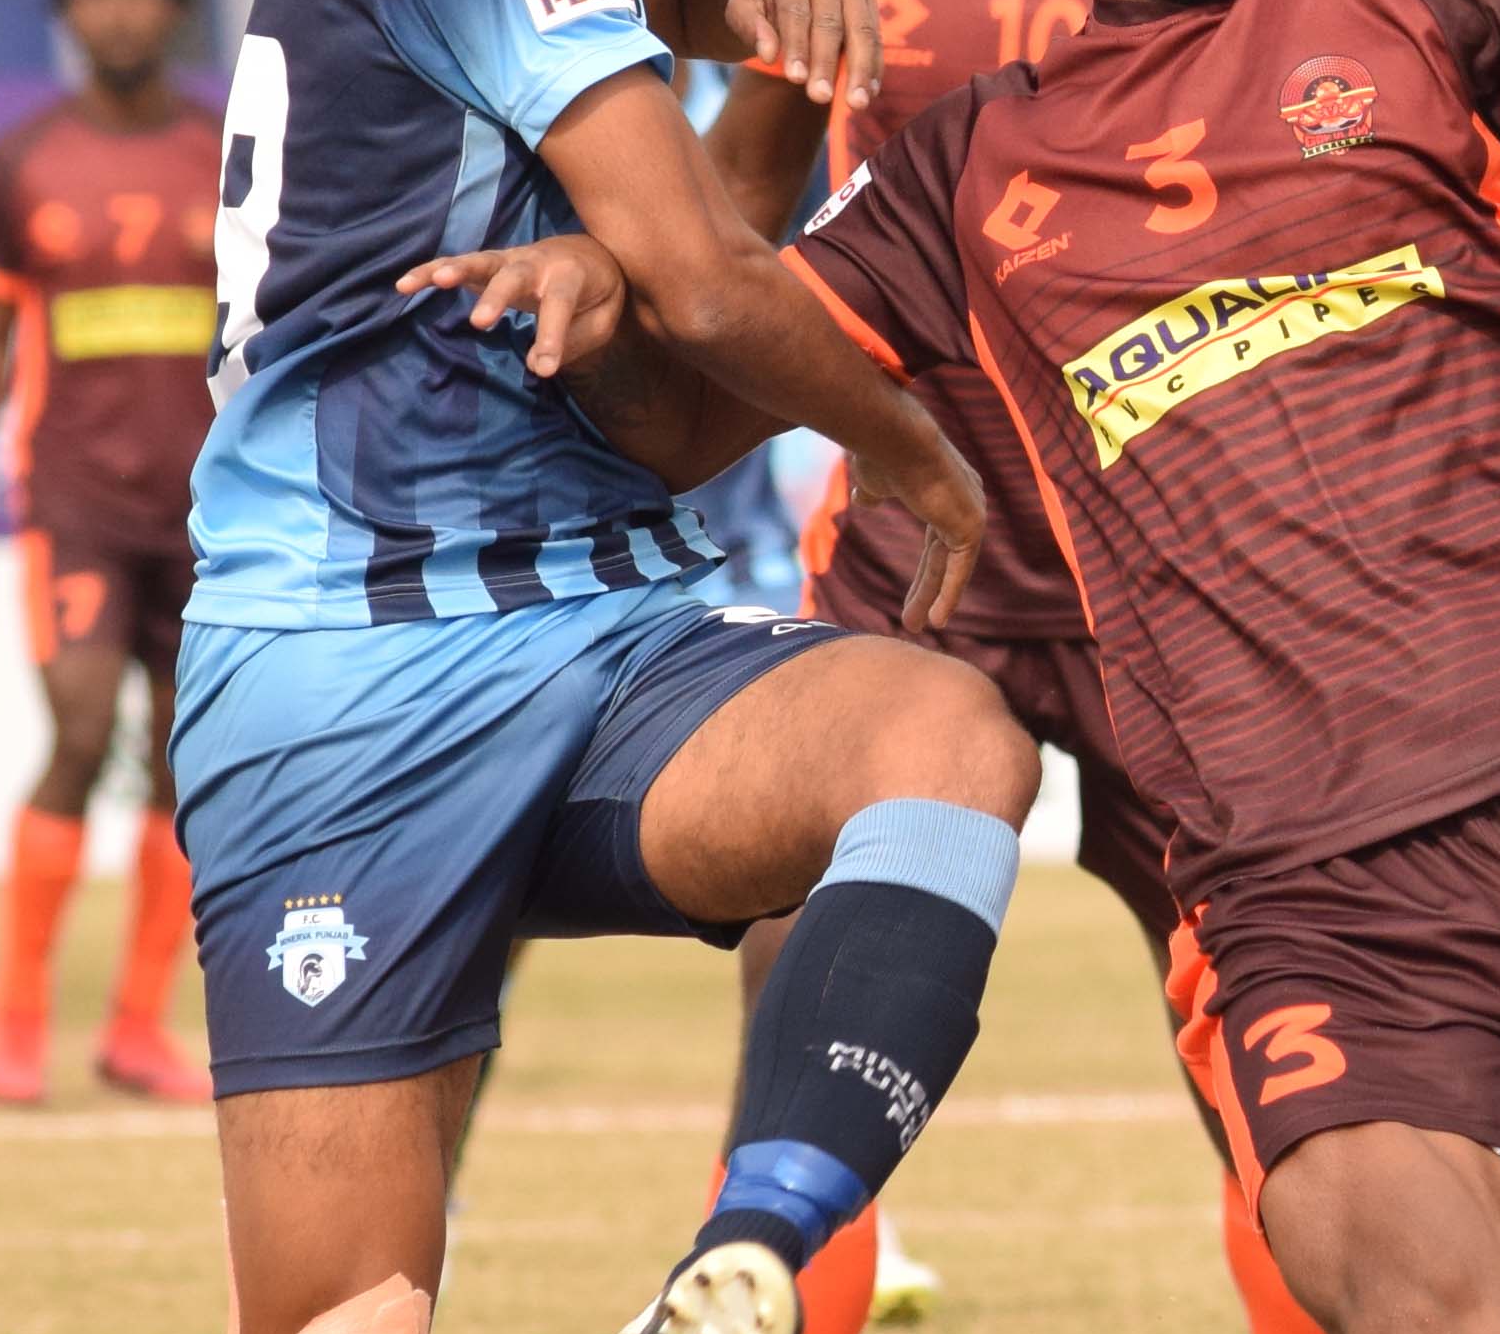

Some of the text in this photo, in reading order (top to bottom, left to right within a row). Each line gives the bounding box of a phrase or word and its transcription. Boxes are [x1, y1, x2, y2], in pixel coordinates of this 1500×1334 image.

[1125, 117, 1219, 235] 3
[994, 232, 1072, 288] KAIZEN
[1073, 262, 1407, 409] AQUAL
[1243, 1002, 1347, 1106] 3
